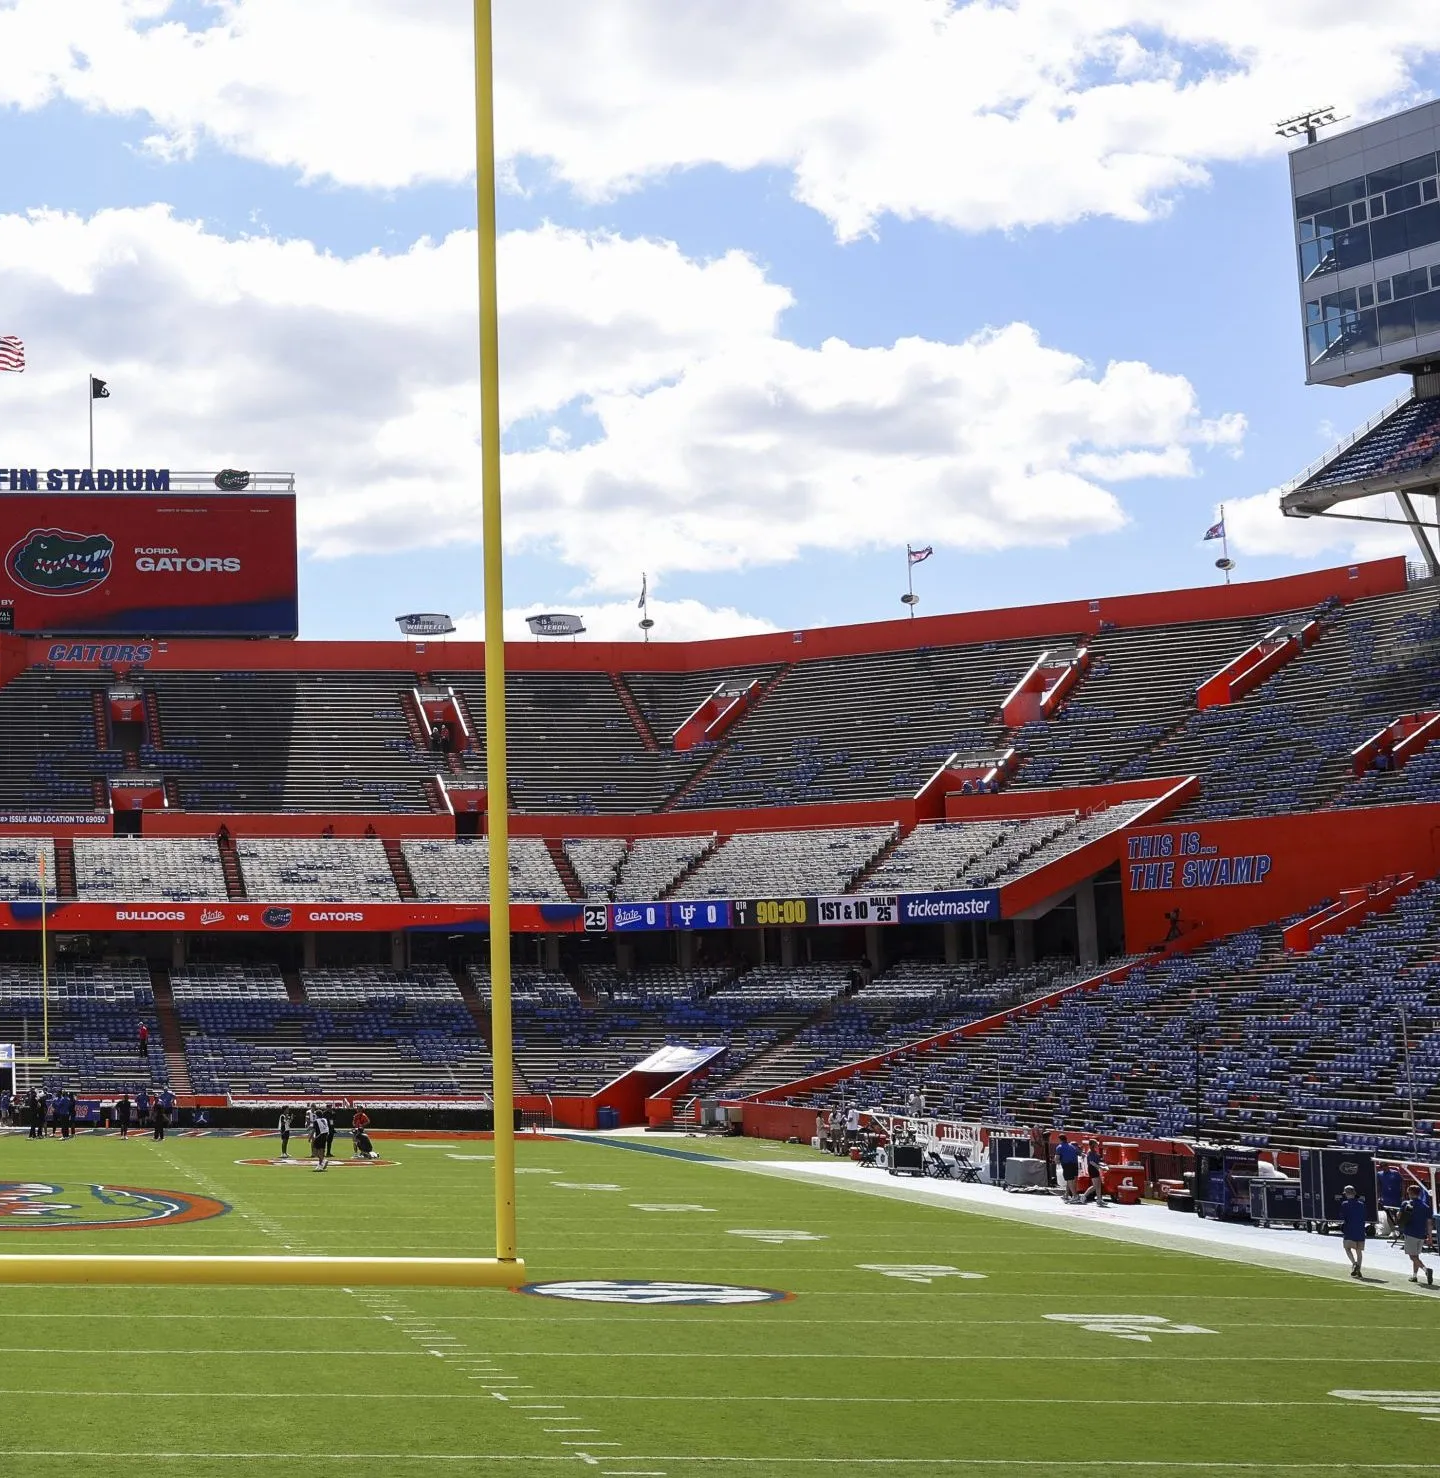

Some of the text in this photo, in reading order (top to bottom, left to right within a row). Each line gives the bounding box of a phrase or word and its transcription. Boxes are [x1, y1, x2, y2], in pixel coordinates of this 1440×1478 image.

[46, 468, 170, 491] STADIUM
[134, 547, 179, 555] FLORIDA
[135, 557, 241, 572] GATORS
[47, 644, 153, 663] GATORS
[9, 815, 27, 823] ISSUE
[1127, 831, 1218, 860] THIS IS...
[1129, 854, 1273, 891] THE SWAMP
[735, 901, 747, 910] QTR
[870, 896, 897, 907] BALL ON
[906, 897, 991, 918] ticketmaster
[115, 911, 185, 921] BULLDOGS
[199, 908, 225, 925] State
[309, 912, 364, 922] GATORS
[585, 911, 606, 926] 25
[614, 908, 642, 926] State
[646, 907, 656, 925] 0
[707, 905, 717, 923] 0
[739, 911, 745, 925] 1
[756, 900, 807, 924] 90:00
[819, 901, 868, 921] 1ST & 10
[876, 906, 892, 922] 25
